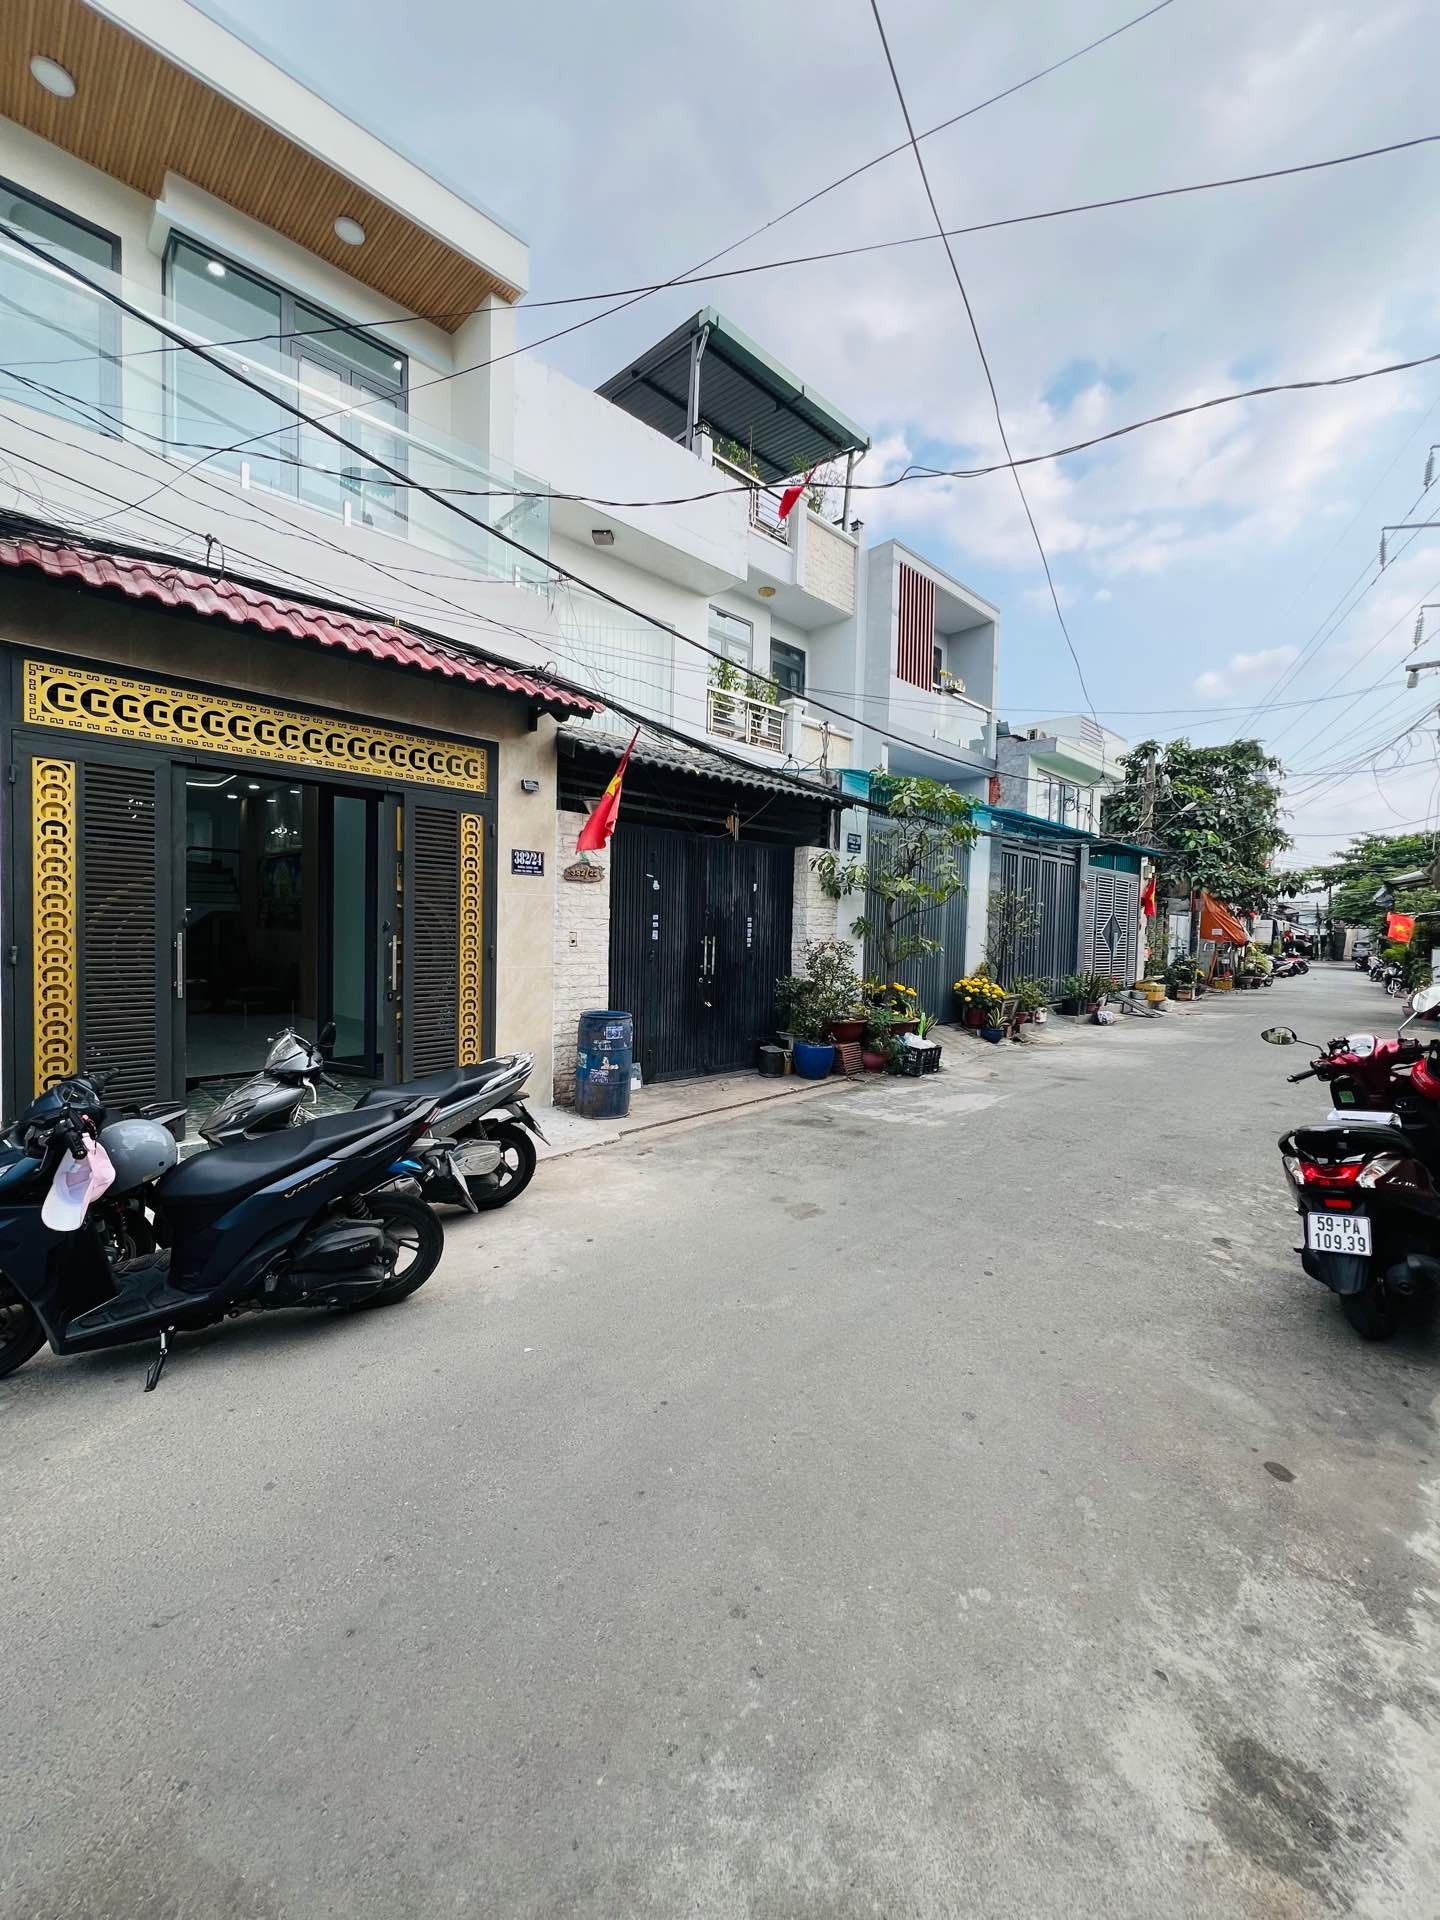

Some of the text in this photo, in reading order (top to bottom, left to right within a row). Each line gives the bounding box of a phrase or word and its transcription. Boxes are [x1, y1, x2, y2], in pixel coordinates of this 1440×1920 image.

[514, 851, 542, 866] 382/24
[1317, 1216, 1361, 1235] 59-PA
[1315, 1232, 1366, 1252] 109.39
